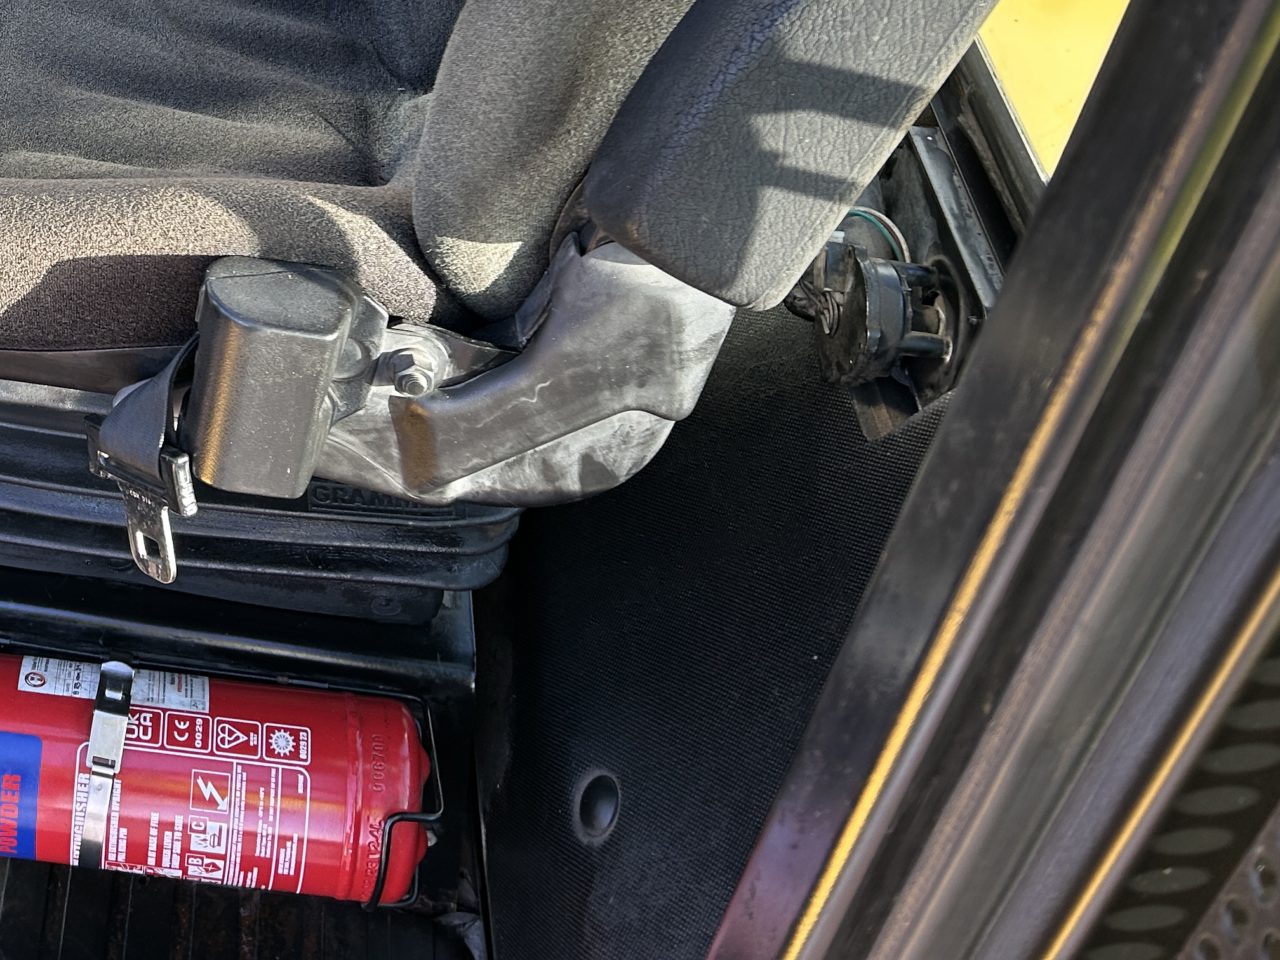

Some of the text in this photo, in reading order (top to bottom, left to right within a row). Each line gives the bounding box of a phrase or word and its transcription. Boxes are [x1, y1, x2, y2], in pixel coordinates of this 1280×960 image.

[139, 713, 153, 740] CA
[174, 719, 189, 741] CE
[195, 718, 203, 748] 0029
[111, 779, 121, 811] UPRIGHT
[0, 773, 22, 854] POWDER
[150, 812, 159, 827] FIRE
[149, 827, 158, 836] OF
[192, 820, 205, 831] C
[188, 857, 203, 865] B
